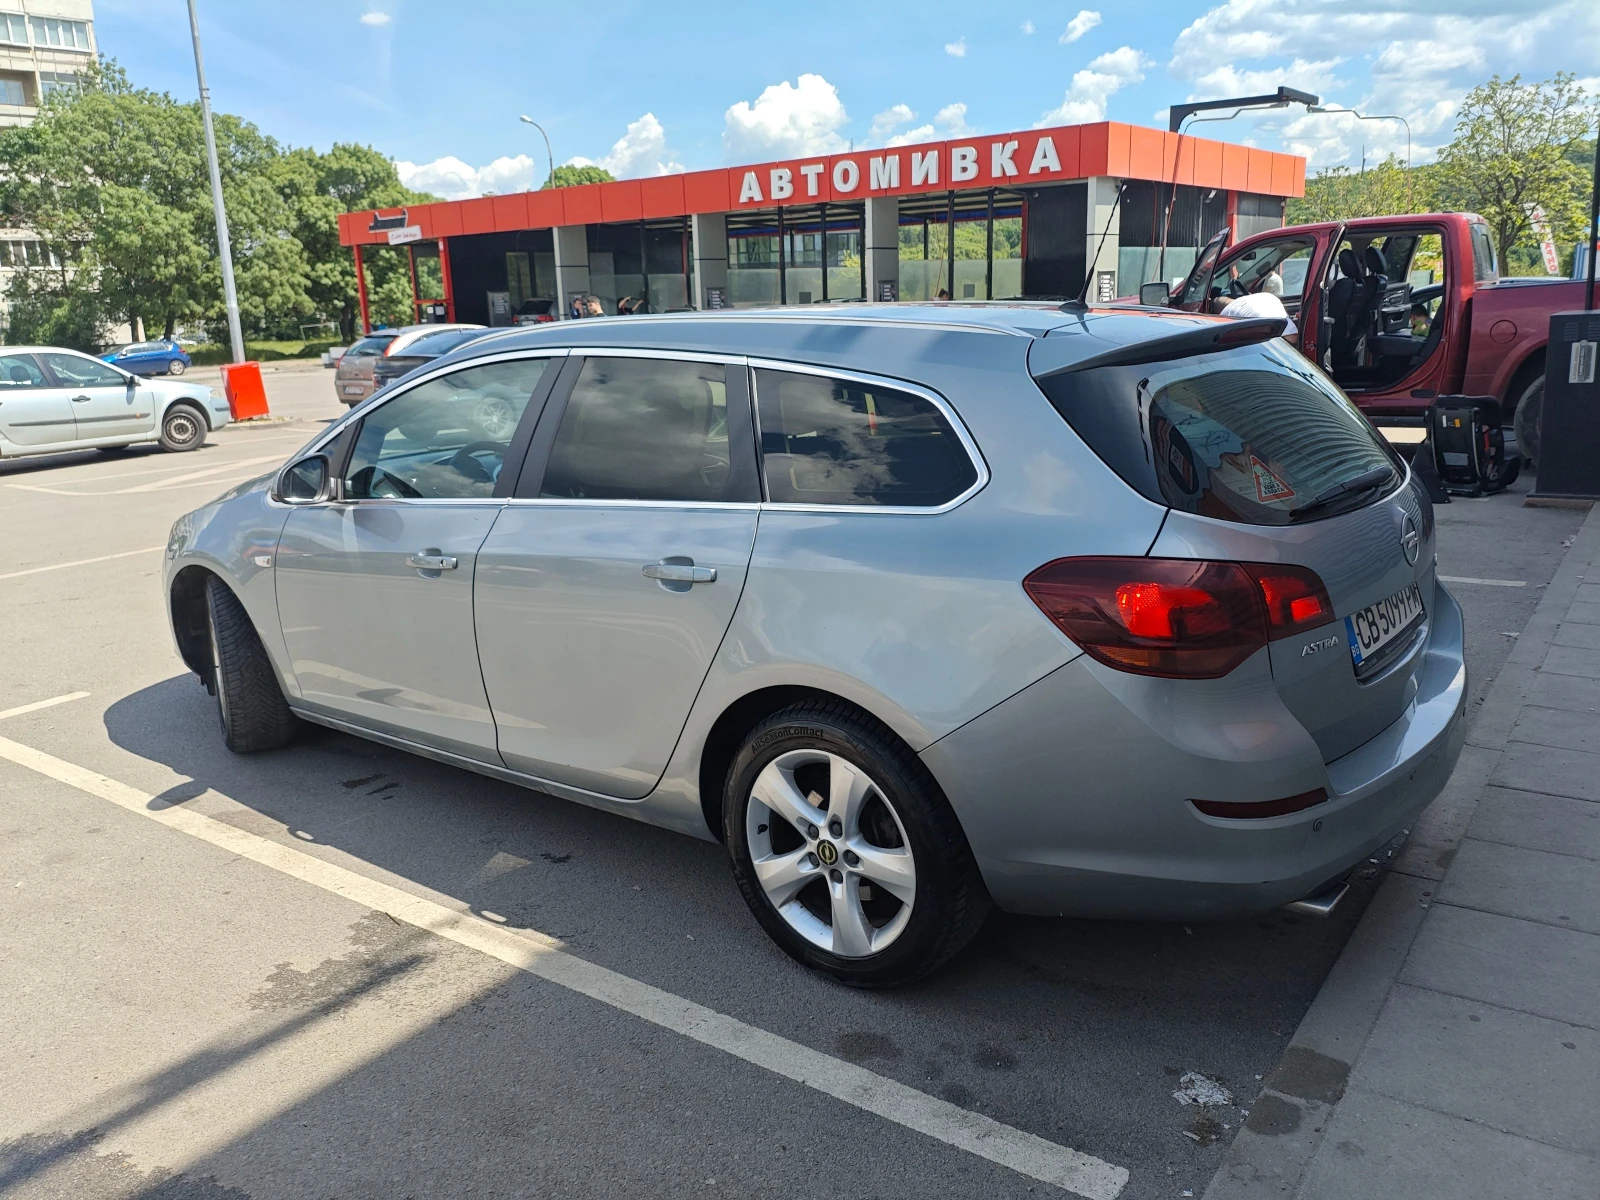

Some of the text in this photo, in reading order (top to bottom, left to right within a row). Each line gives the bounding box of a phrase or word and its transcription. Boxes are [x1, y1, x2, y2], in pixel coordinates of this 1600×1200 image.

[738, 136, 1062, 204] АВТОМИВКА
[1301, 635, 1339, 657] ASTRA
[1351, 644, 1361, 658] BG
[751, 726, 824, 754] AllSeasonContact
